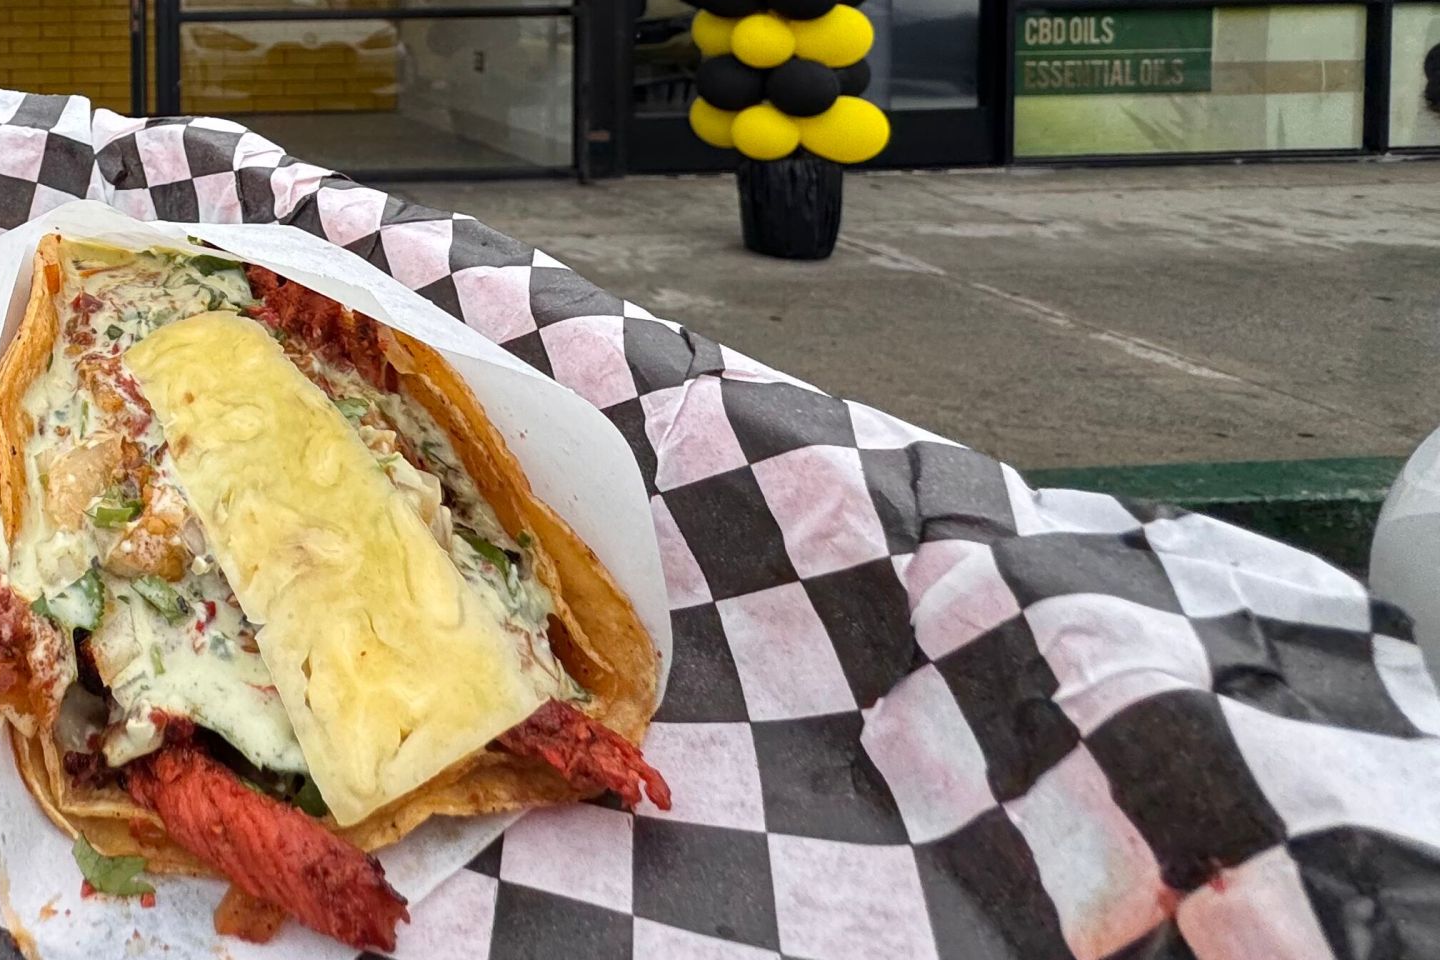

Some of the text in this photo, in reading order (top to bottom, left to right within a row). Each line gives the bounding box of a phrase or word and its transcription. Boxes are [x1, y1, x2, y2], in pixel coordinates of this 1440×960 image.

[1024, 15, 1115, 46] CBD OILS
[1023, 57, 1185, 90] ESSENTIAL OILS
